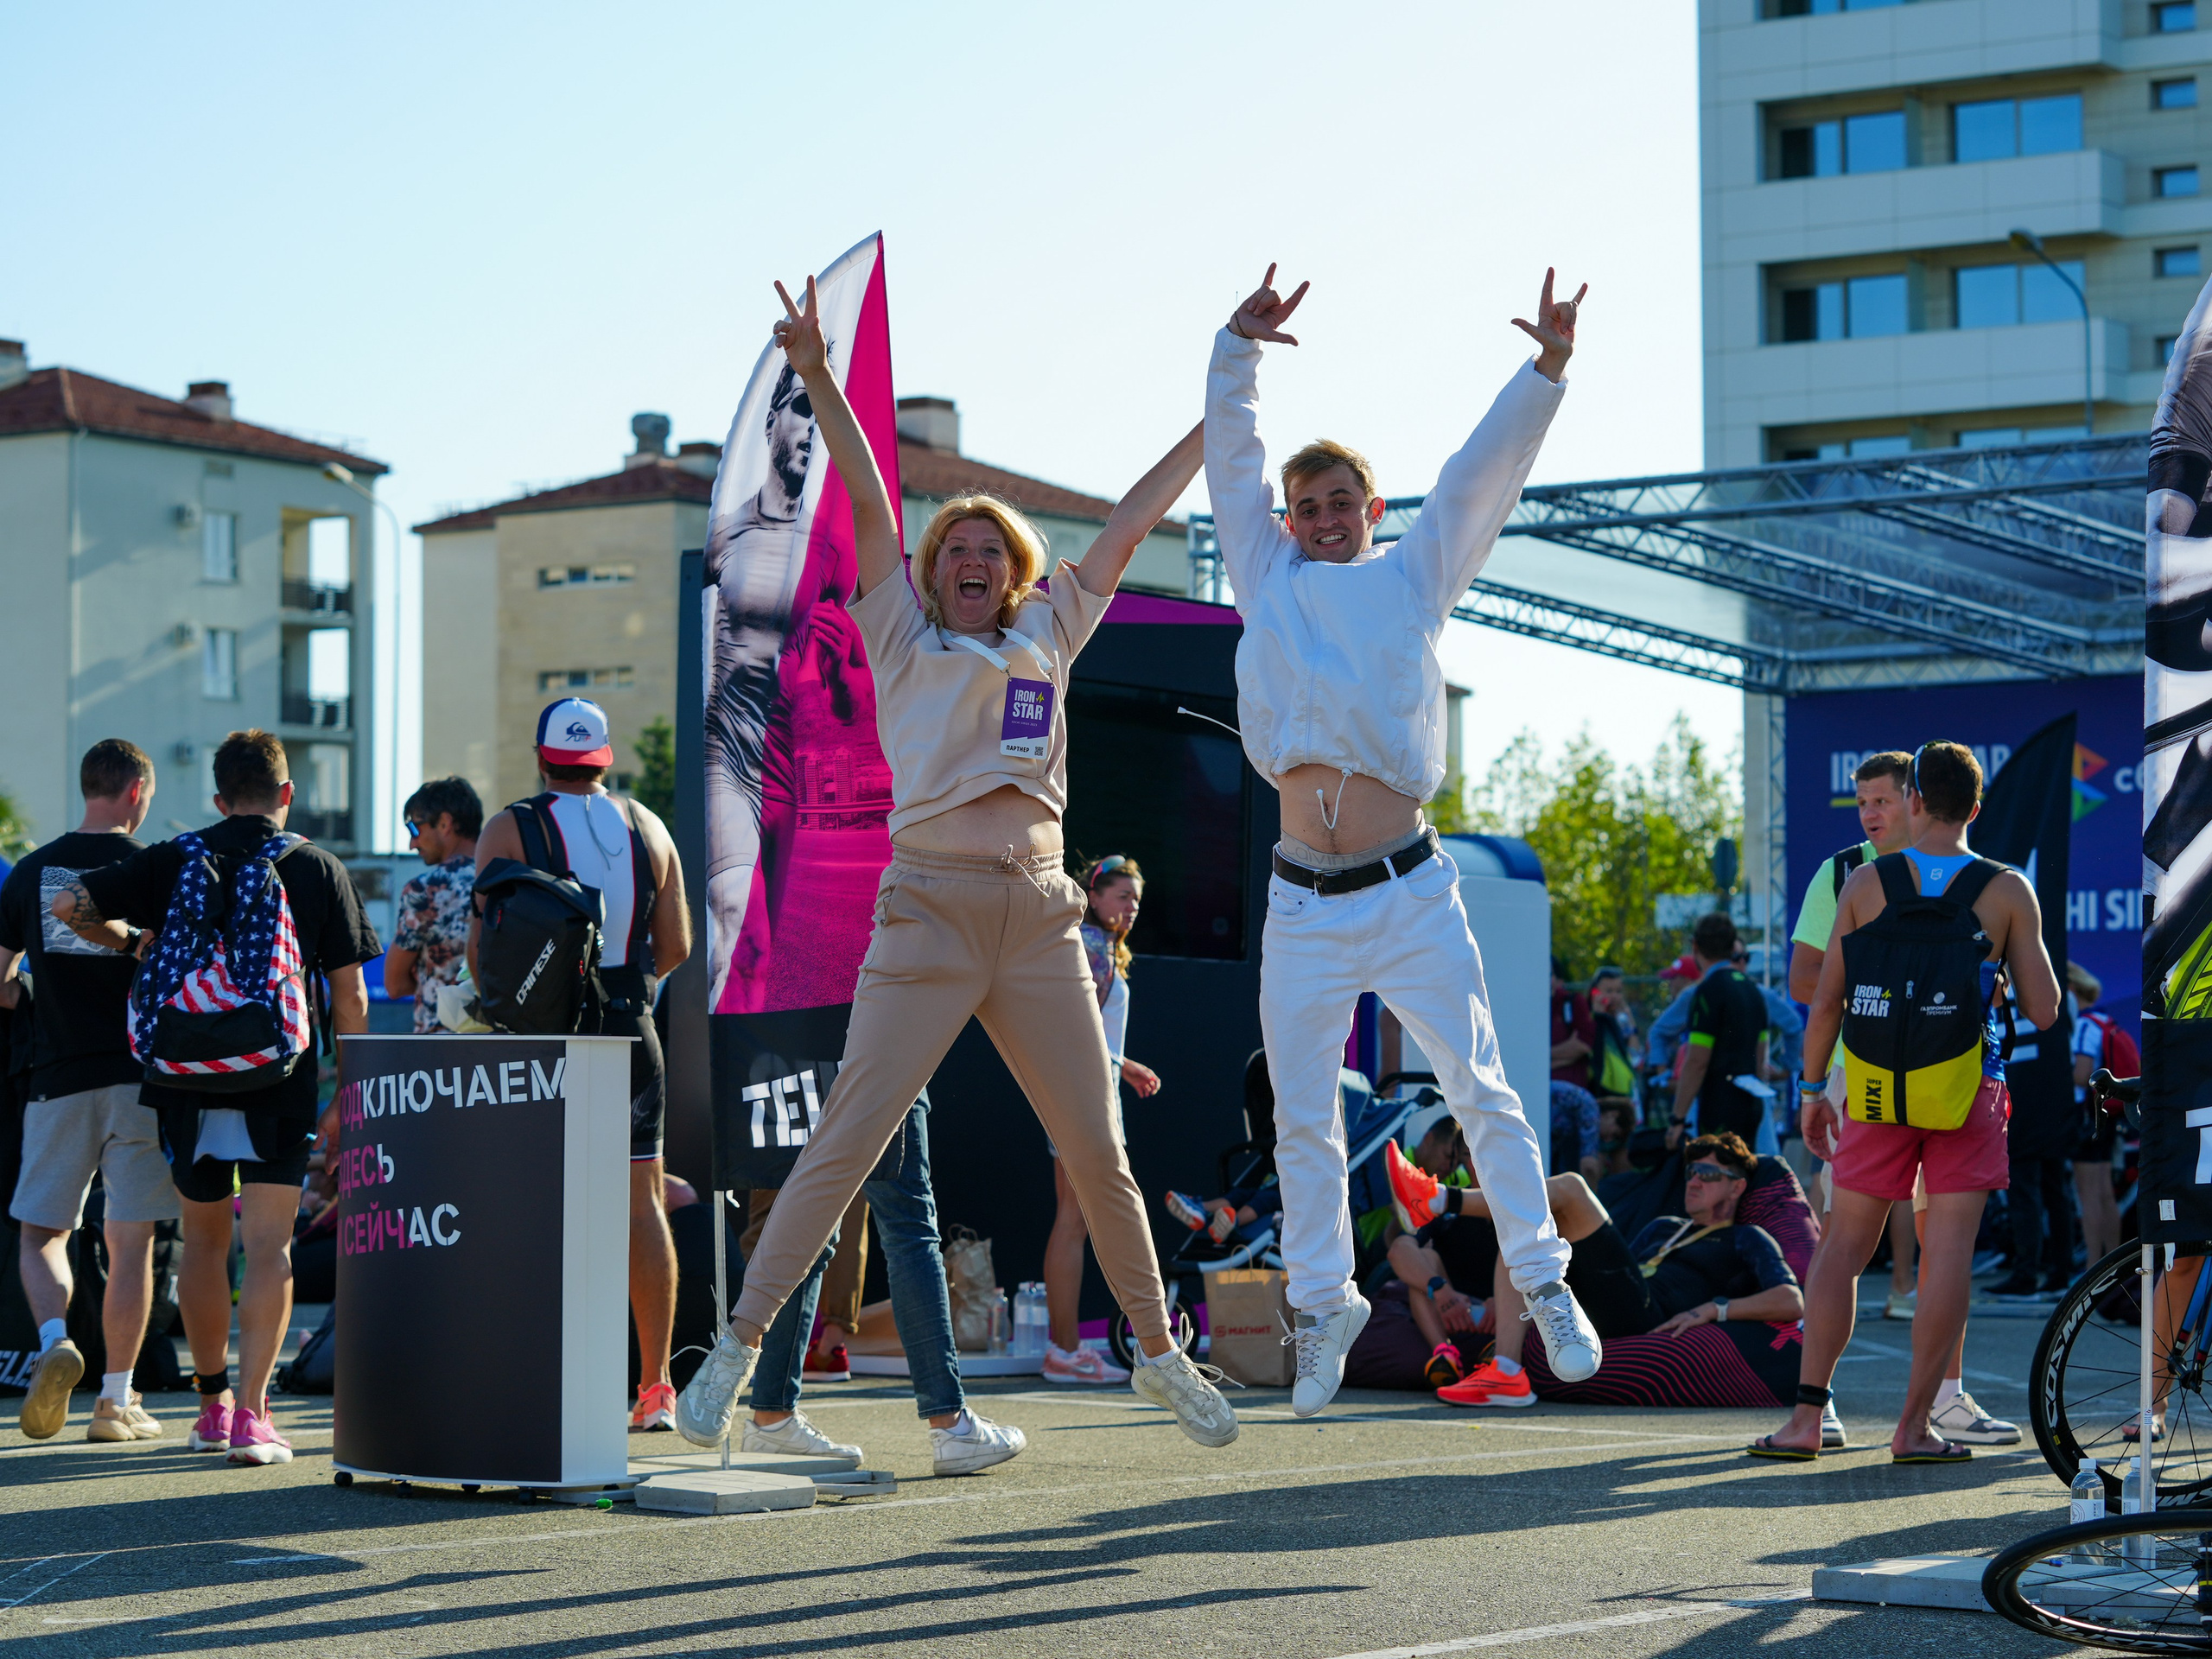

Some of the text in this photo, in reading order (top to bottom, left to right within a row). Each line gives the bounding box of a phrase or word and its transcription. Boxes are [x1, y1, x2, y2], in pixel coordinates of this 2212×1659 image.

[1014, 689, 1036, 703] IRON
[1012, 702, 1044, 721] STAR
[515, 938, 556, 1006] DAINESE
[1854, 984, 1883, 999] IRON
[1851, 997, 1890, 1018] STAR
[1866, 1084, 1883, 1121] MIX
[345, 1201, 461, 1256] СЕЙЧАС
[1228, 1325, 1272, 1336] МАГНИТ
